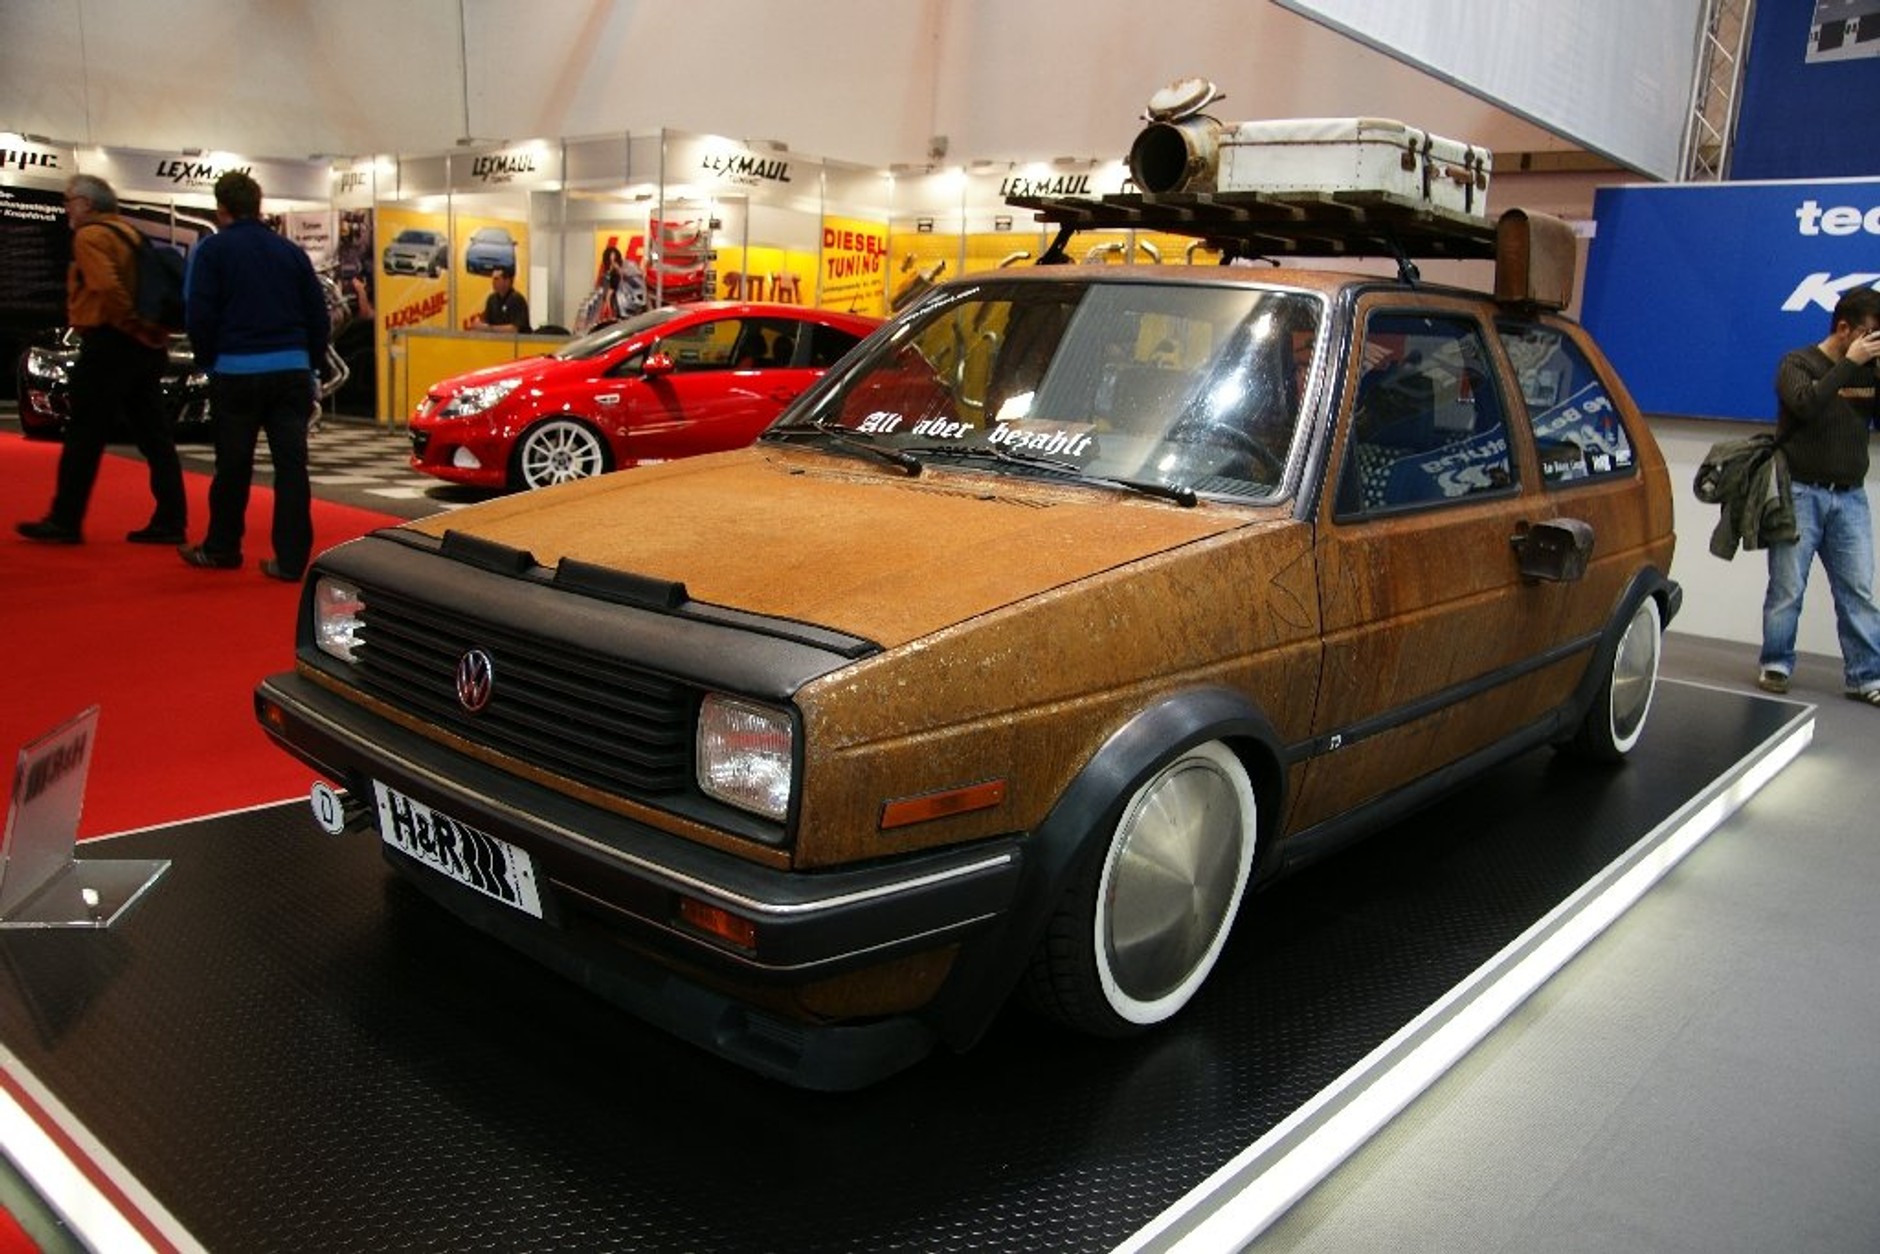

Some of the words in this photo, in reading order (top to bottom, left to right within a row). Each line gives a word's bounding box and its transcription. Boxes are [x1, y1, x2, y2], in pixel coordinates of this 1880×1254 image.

[156, 160, 252, 183] LEXM
[472, 154, 535, 182] LEXMAUL
[702, 155, 791, 183] LEXMAUL
[999, 175, 1091, 198] LEXMAUL
[823, 227, 887, 257] DIESEL
[828, 255, 879, 280] TUNING
[912, 416, 974, 439] aber
[988, 422, 1092, 457] bezahlt
